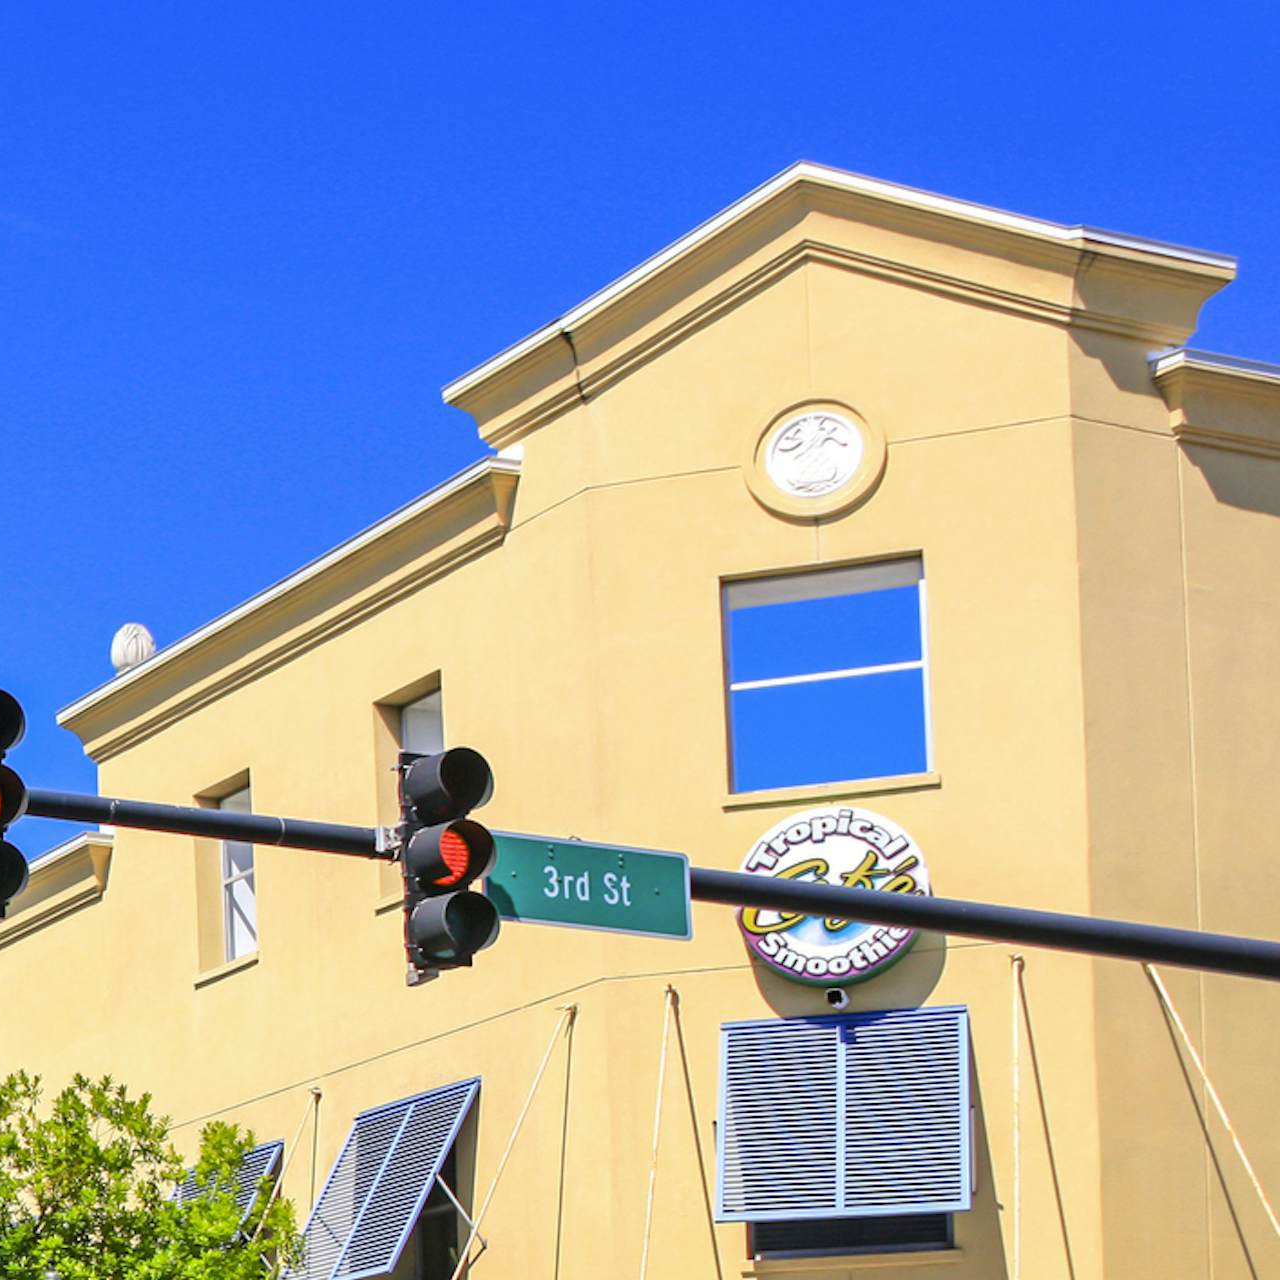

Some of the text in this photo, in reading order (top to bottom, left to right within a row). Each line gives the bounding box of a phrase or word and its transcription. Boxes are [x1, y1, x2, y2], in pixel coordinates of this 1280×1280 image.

[746, 809, 910, 873] Tropical
[543, 865, 632, 906] 3rd St
